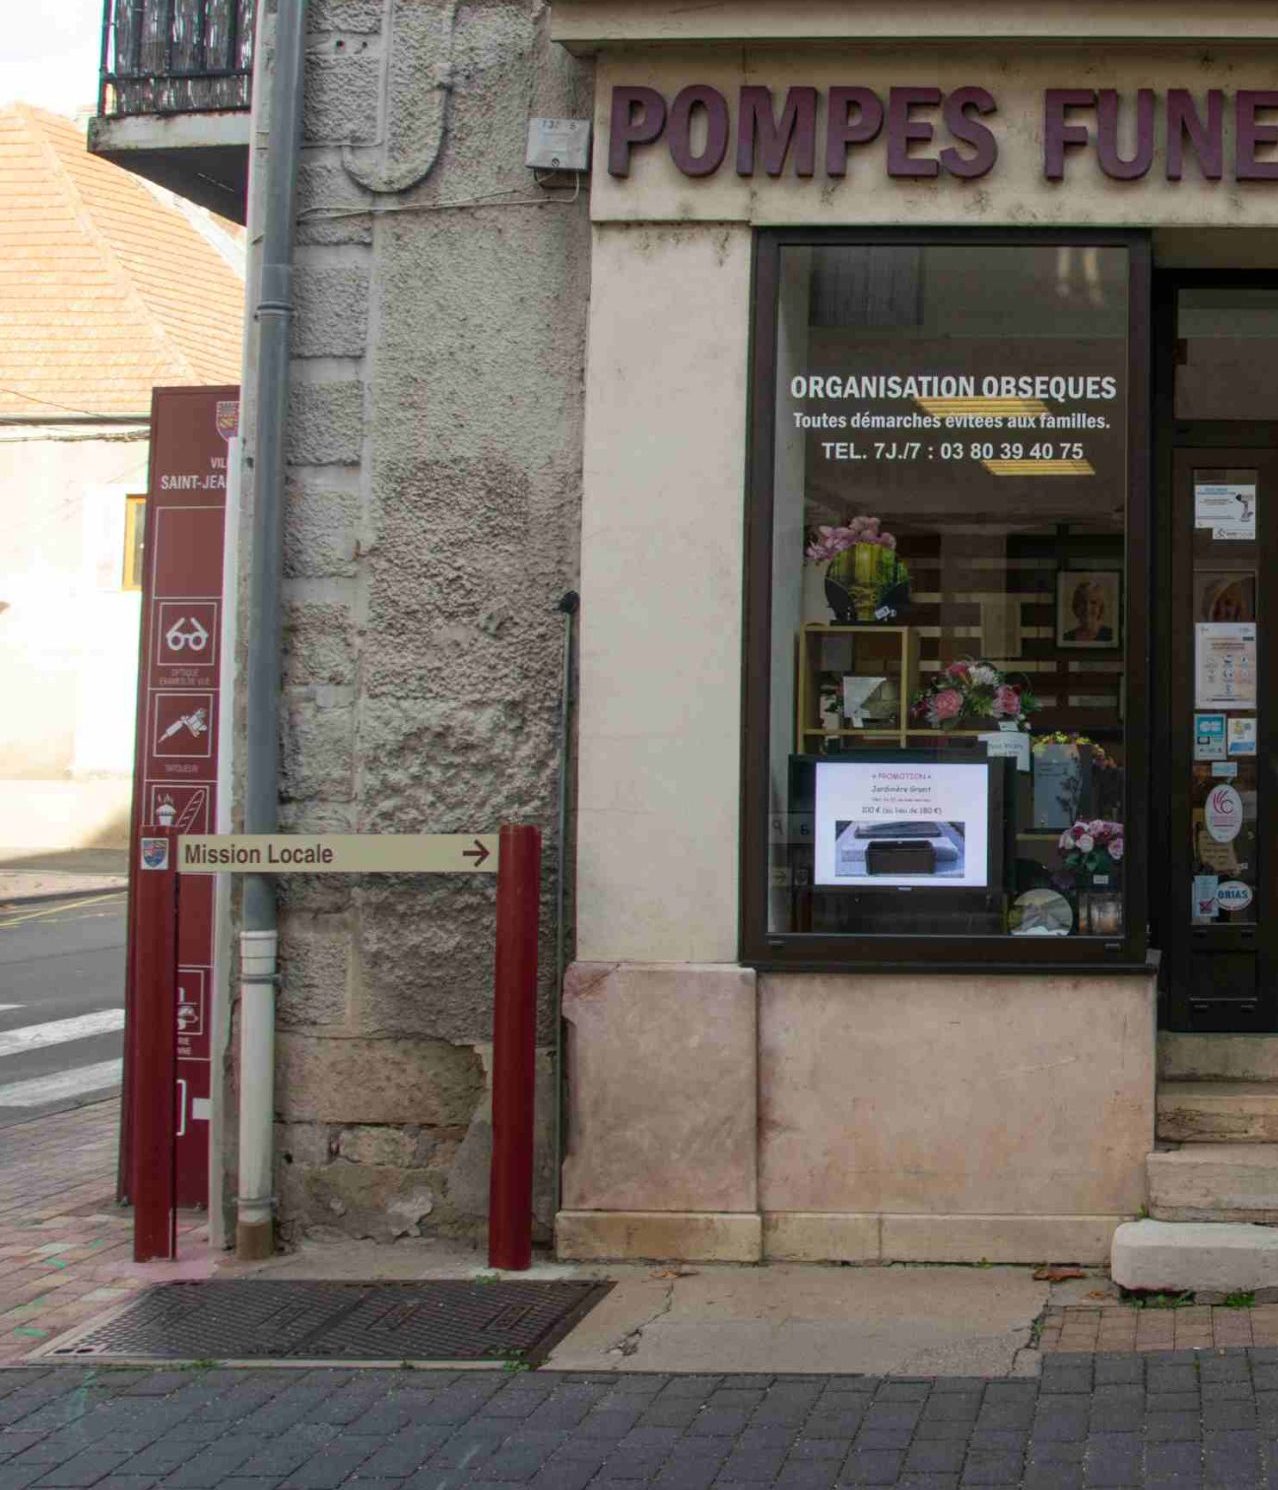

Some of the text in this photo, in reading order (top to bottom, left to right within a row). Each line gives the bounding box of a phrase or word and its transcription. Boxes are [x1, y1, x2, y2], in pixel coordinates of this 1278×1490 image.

[607, 84, 998, 180] POMPES
[790, 375, 1118, 402] ORGANISATION OBSEQUES
[793, 412, 848, 429] Toutes
[850, 410, 942, 429] démarches
[1007, 416, 1037, 429] aux
[1040, 412, 1111, 429] familles.
[822, 442, 867, 460] TEL.
[940, 442, 964, 460] 03
[970, 442, 994, 460] 80
[1000, 442, 1024, 460] 39
[1029, 442, 1054, 460] 40
[1060, 442, 1084, 460] 75
[210, 457, 228, 469] VIL
[161, 474, 229, 490] SAINT-JEA
[878, 772, 926, 780] PROMOTION
[184, 843, 334, 864] Mission Locale
